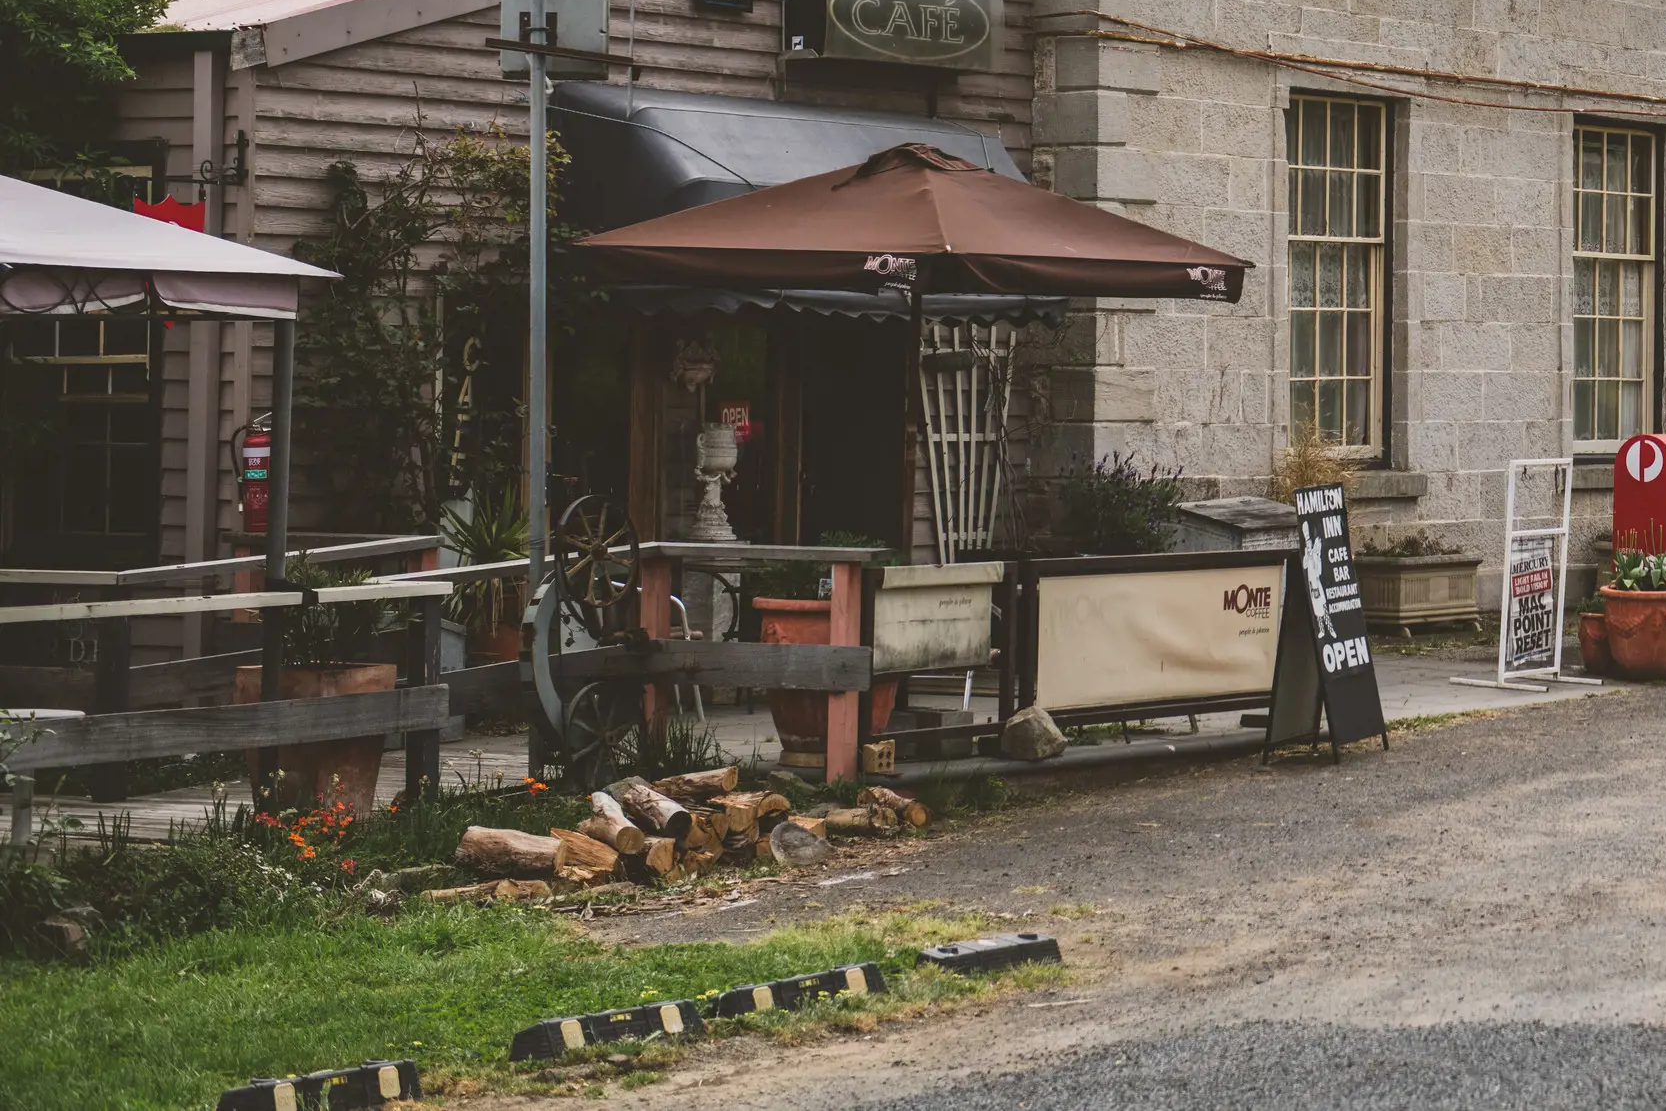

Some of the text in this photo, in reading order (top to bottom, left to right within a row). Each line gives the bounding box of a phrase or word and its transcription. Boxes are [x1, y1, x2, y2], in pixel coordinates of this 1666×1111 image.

[863, 254, 916, 275] MONTE
[1186, 266, 1226, 285] MONTE
[722, 407, 749, 426] OPEN
[1295, 487, 1343, 515] HAMILTON
[1322, 515, 1343, 539] INN
[1328, 546, 1349, 564] CAFE
[1511, 555, 1549, 575] MERCURY
[1333, 565, 1351, 583] BAR
[1514, 575, 1530, 586] LIGHT
[1223, 584, 1271, 614] MONTE
[1325, 583, 1358, 600] RESTAURANT
[1246, 607, 1270, 619] COFFEE
[1518, 593, 1546, 616] MAC
[1513, 611, 1552, 636] POINT
[1515, 629, 1551, 655] RESET
[1322, 636, 1370, 674] OPEN
